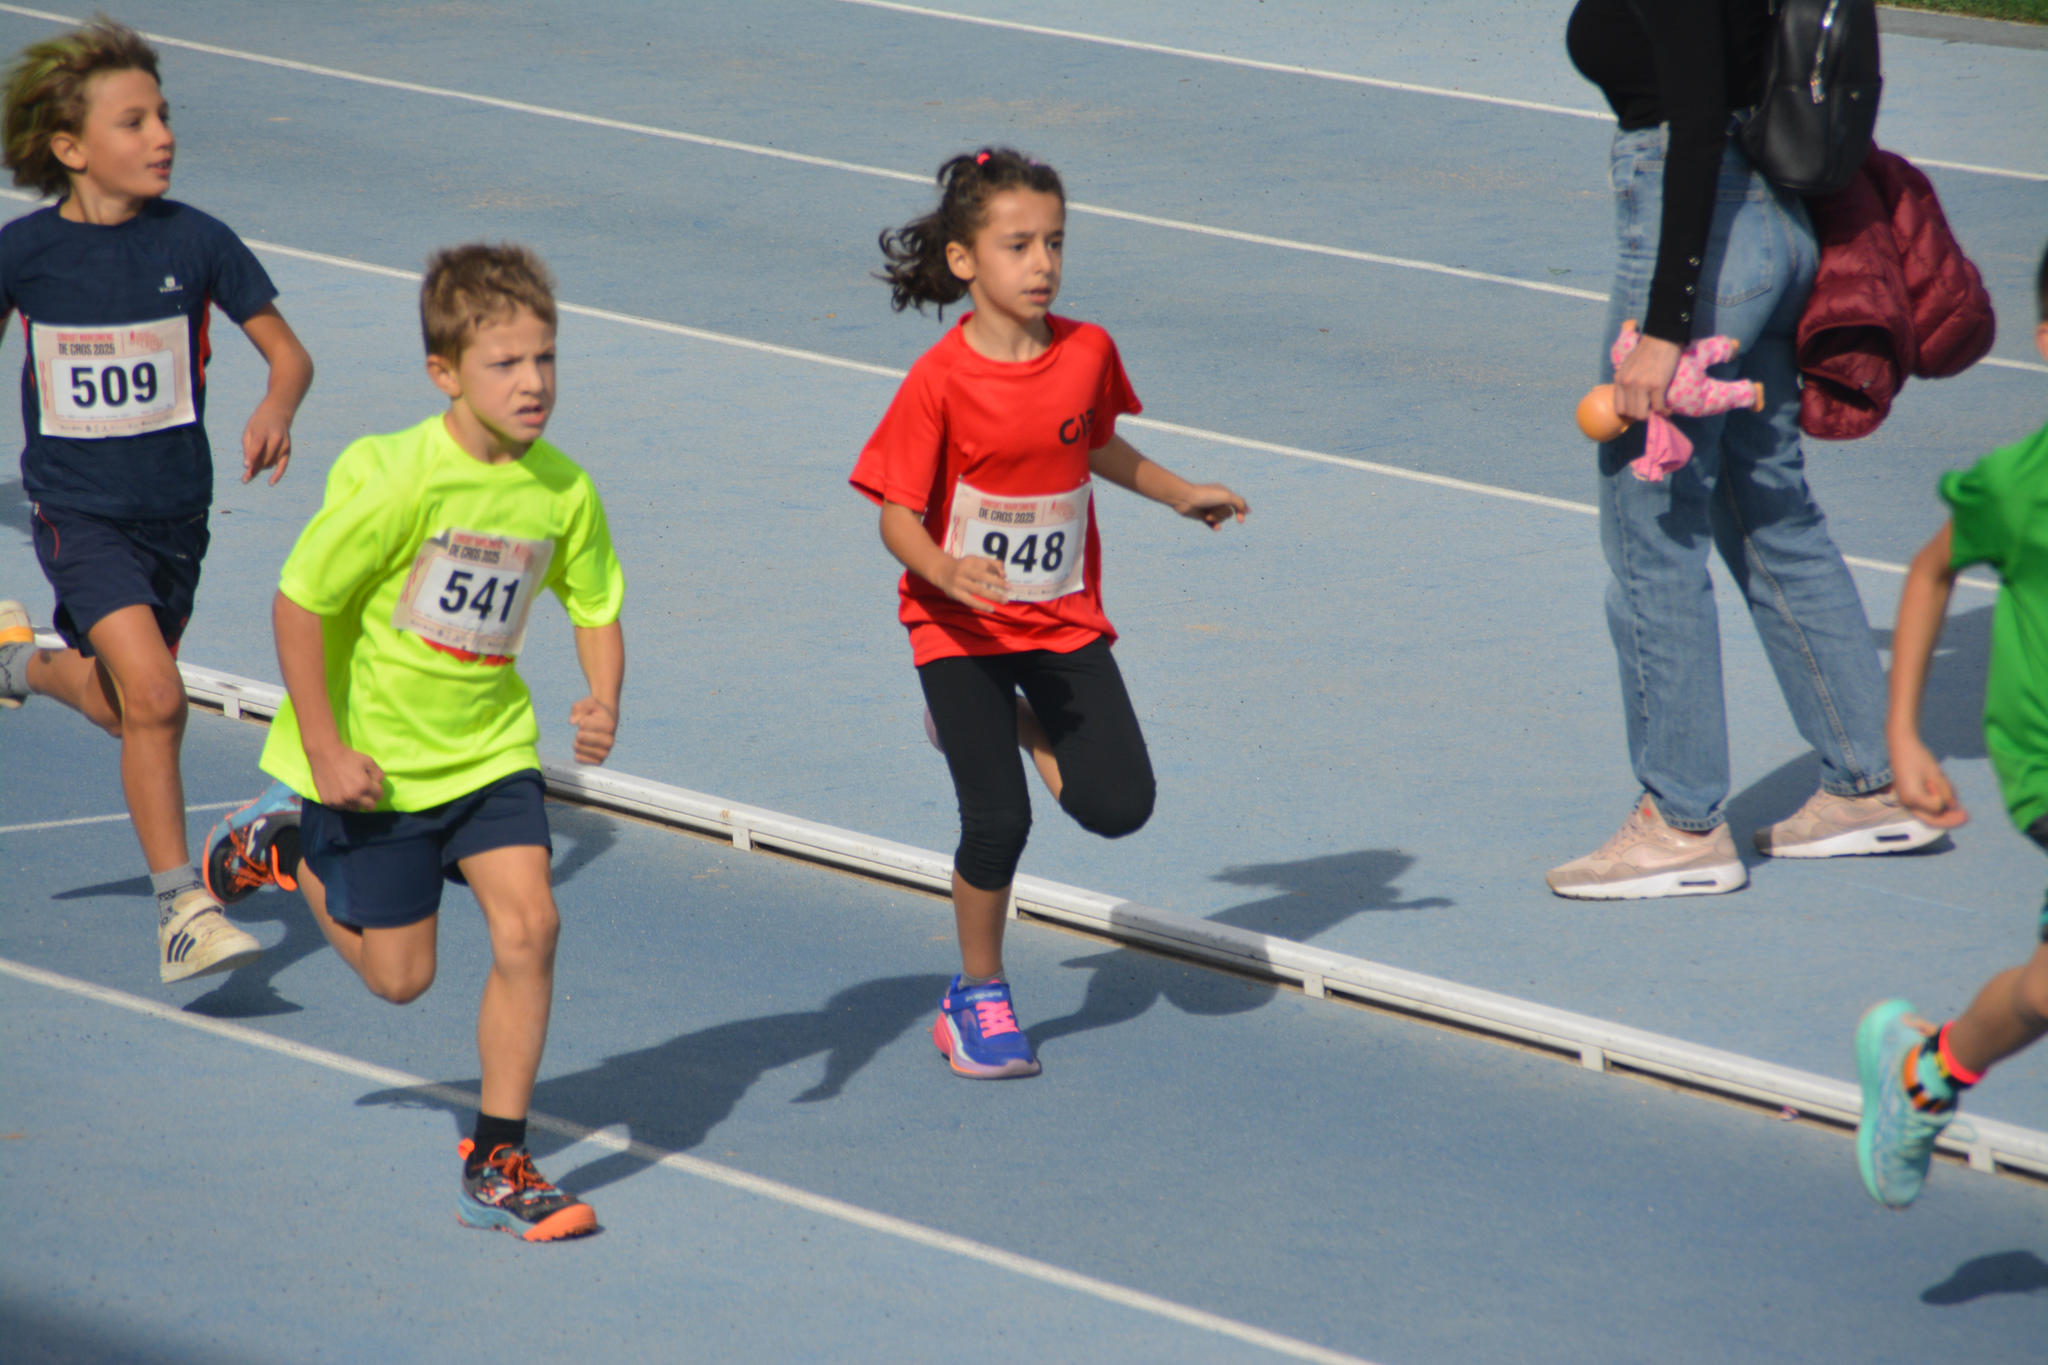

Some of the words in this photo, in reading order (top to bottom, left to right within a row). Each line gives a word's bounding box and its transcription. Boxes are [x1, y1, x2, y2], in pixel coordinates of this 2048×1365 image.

[58, 343, 69, 355] DE
[70, 343, 92, 356] CROS
[94, 343, 116, 355] 2025
[71, 362, 158, 408] 509
[979, 507, 989, 519] DE
[990, 509, 1013, 523] CROS
[1014, 511, 1036, 524] 2025
[982, 531, 1065, 573] 948
[439, 569, 520, 623] 541
